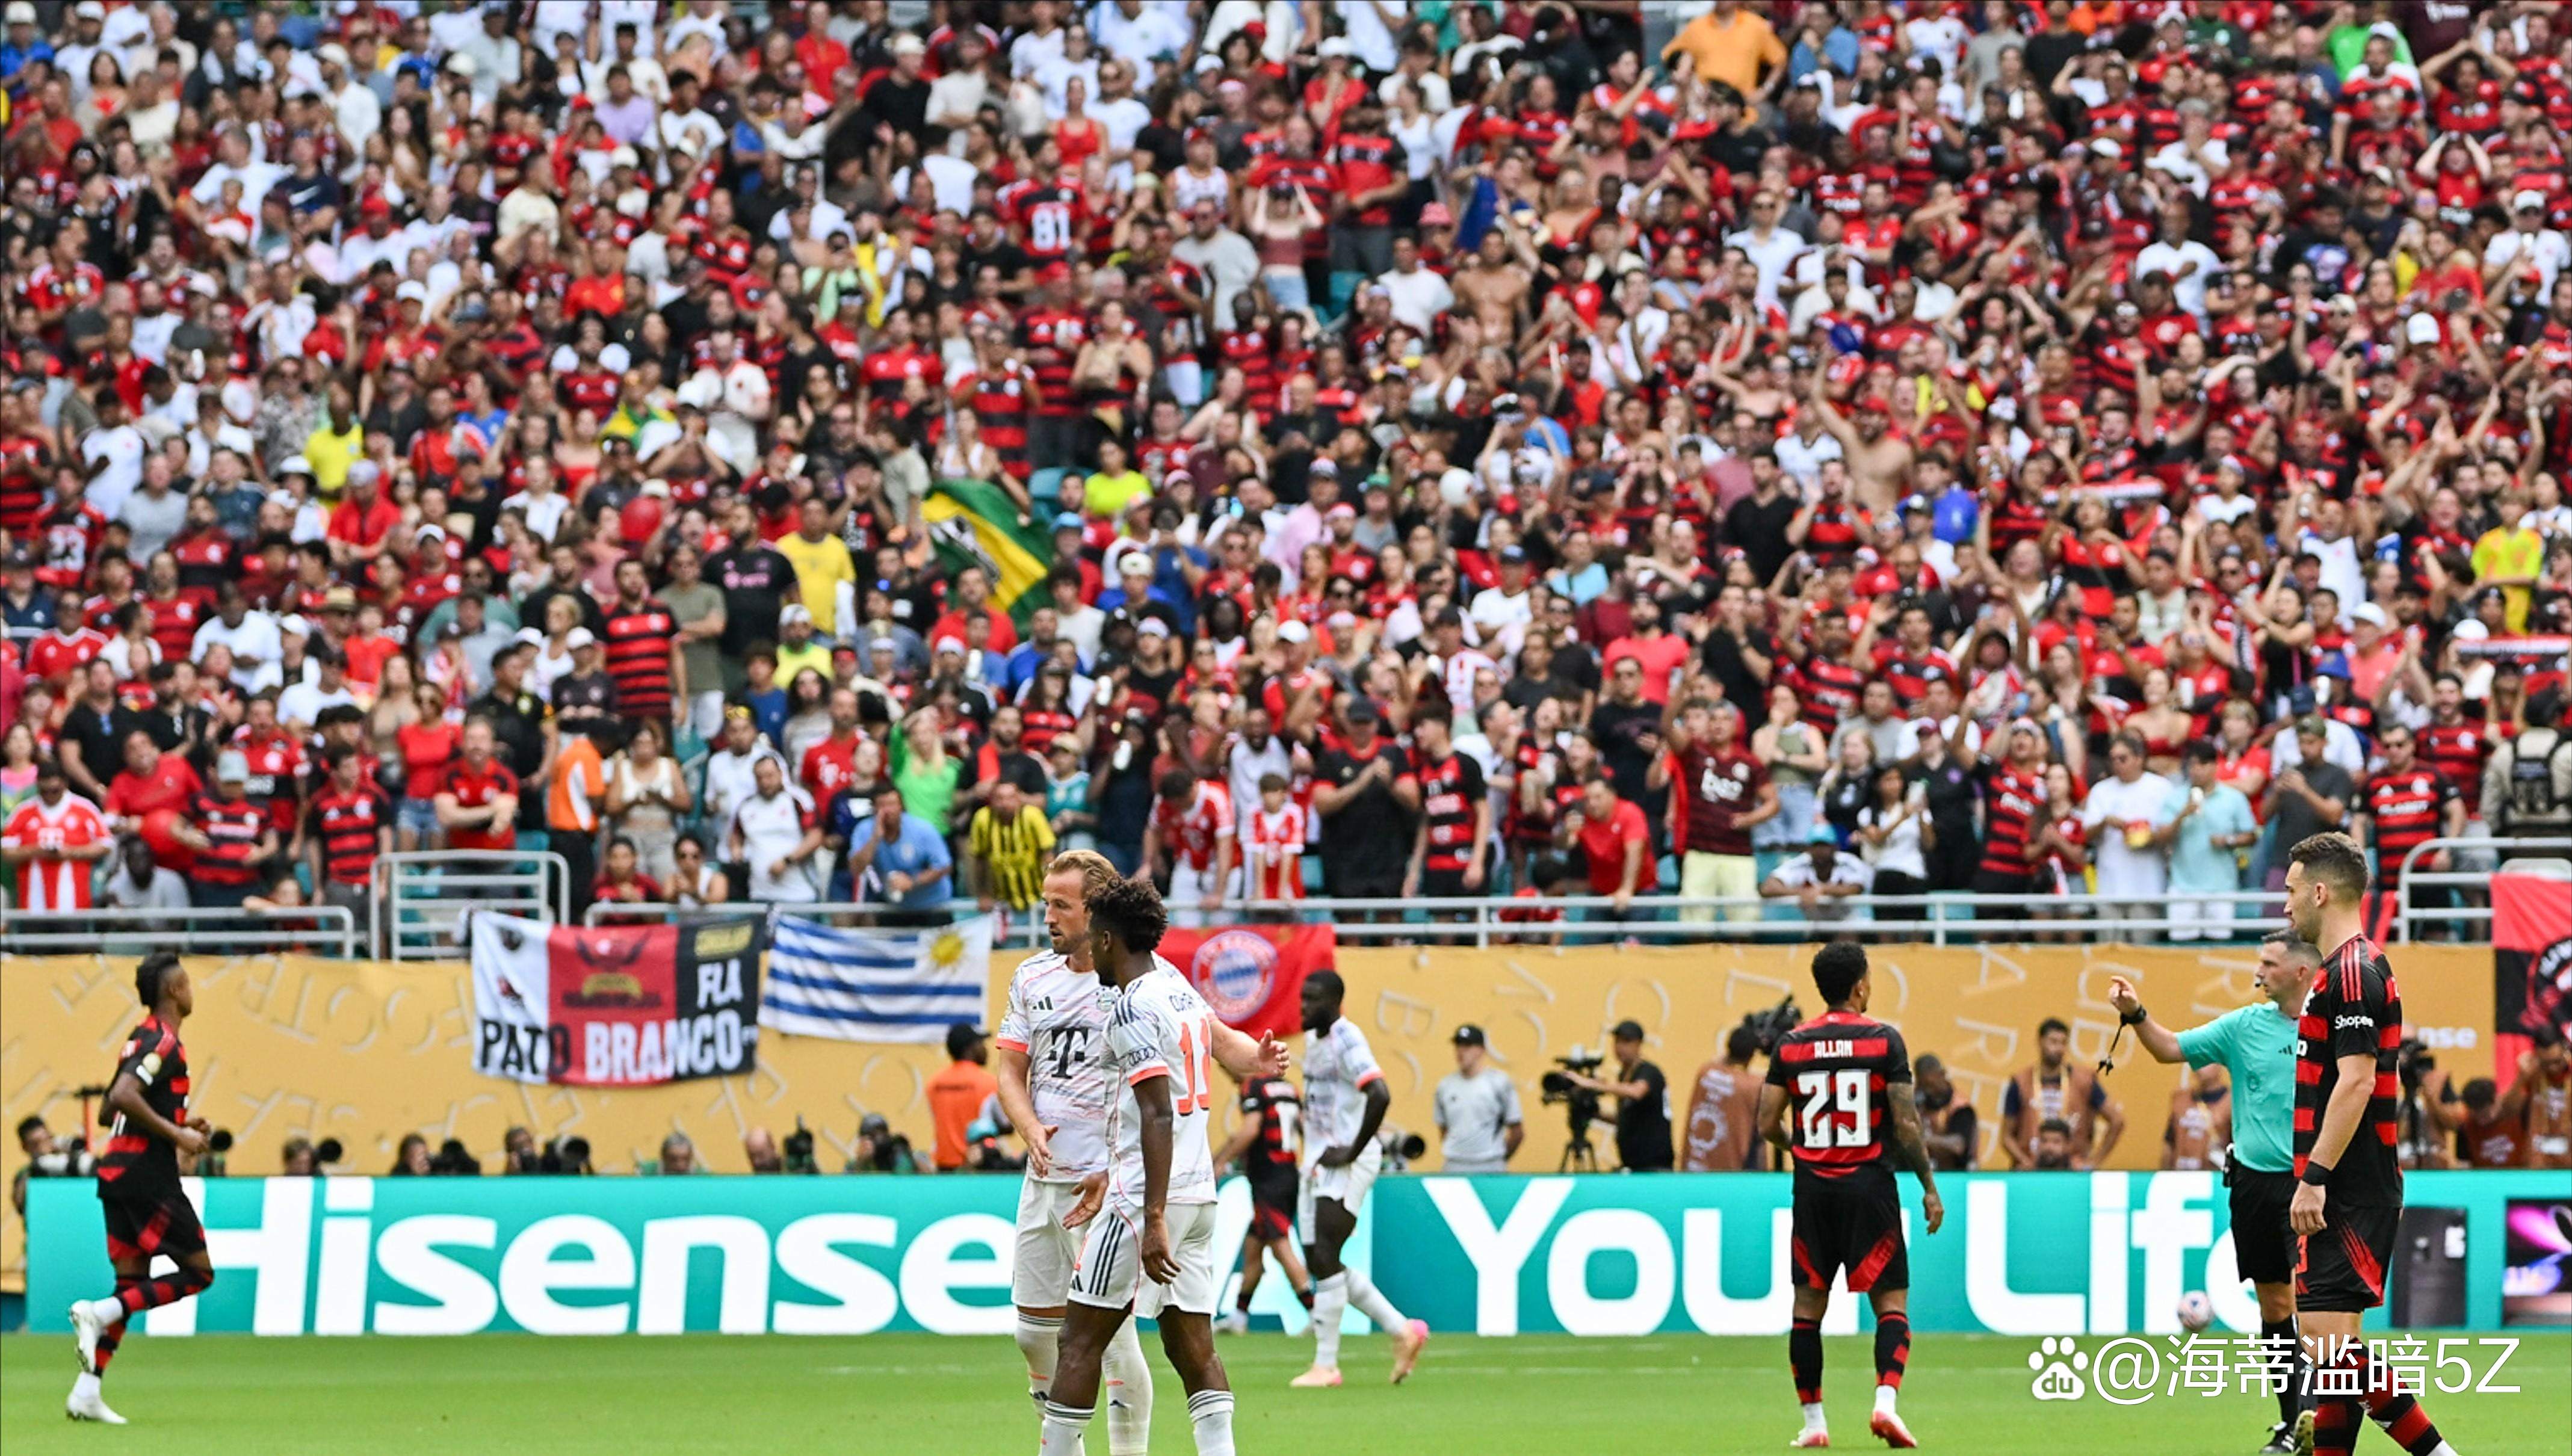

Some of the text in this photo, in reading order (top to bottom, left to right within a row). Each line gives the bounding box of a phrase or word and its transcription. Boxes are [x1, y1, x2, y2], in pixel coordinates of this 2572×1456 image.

[697, 957, 743, 1009] FLA
[481, 1019, 570, 1076] PATO
[584, 1008, 744, 1081] BRANCO
[1814, 1040, 1853, 1059] ALLAN
[2334, 1014, 2375, 1029] Shopee
[1798, 1068, 1871, 1148] 29
[145, 1176, 1015, 1335] Hisense
